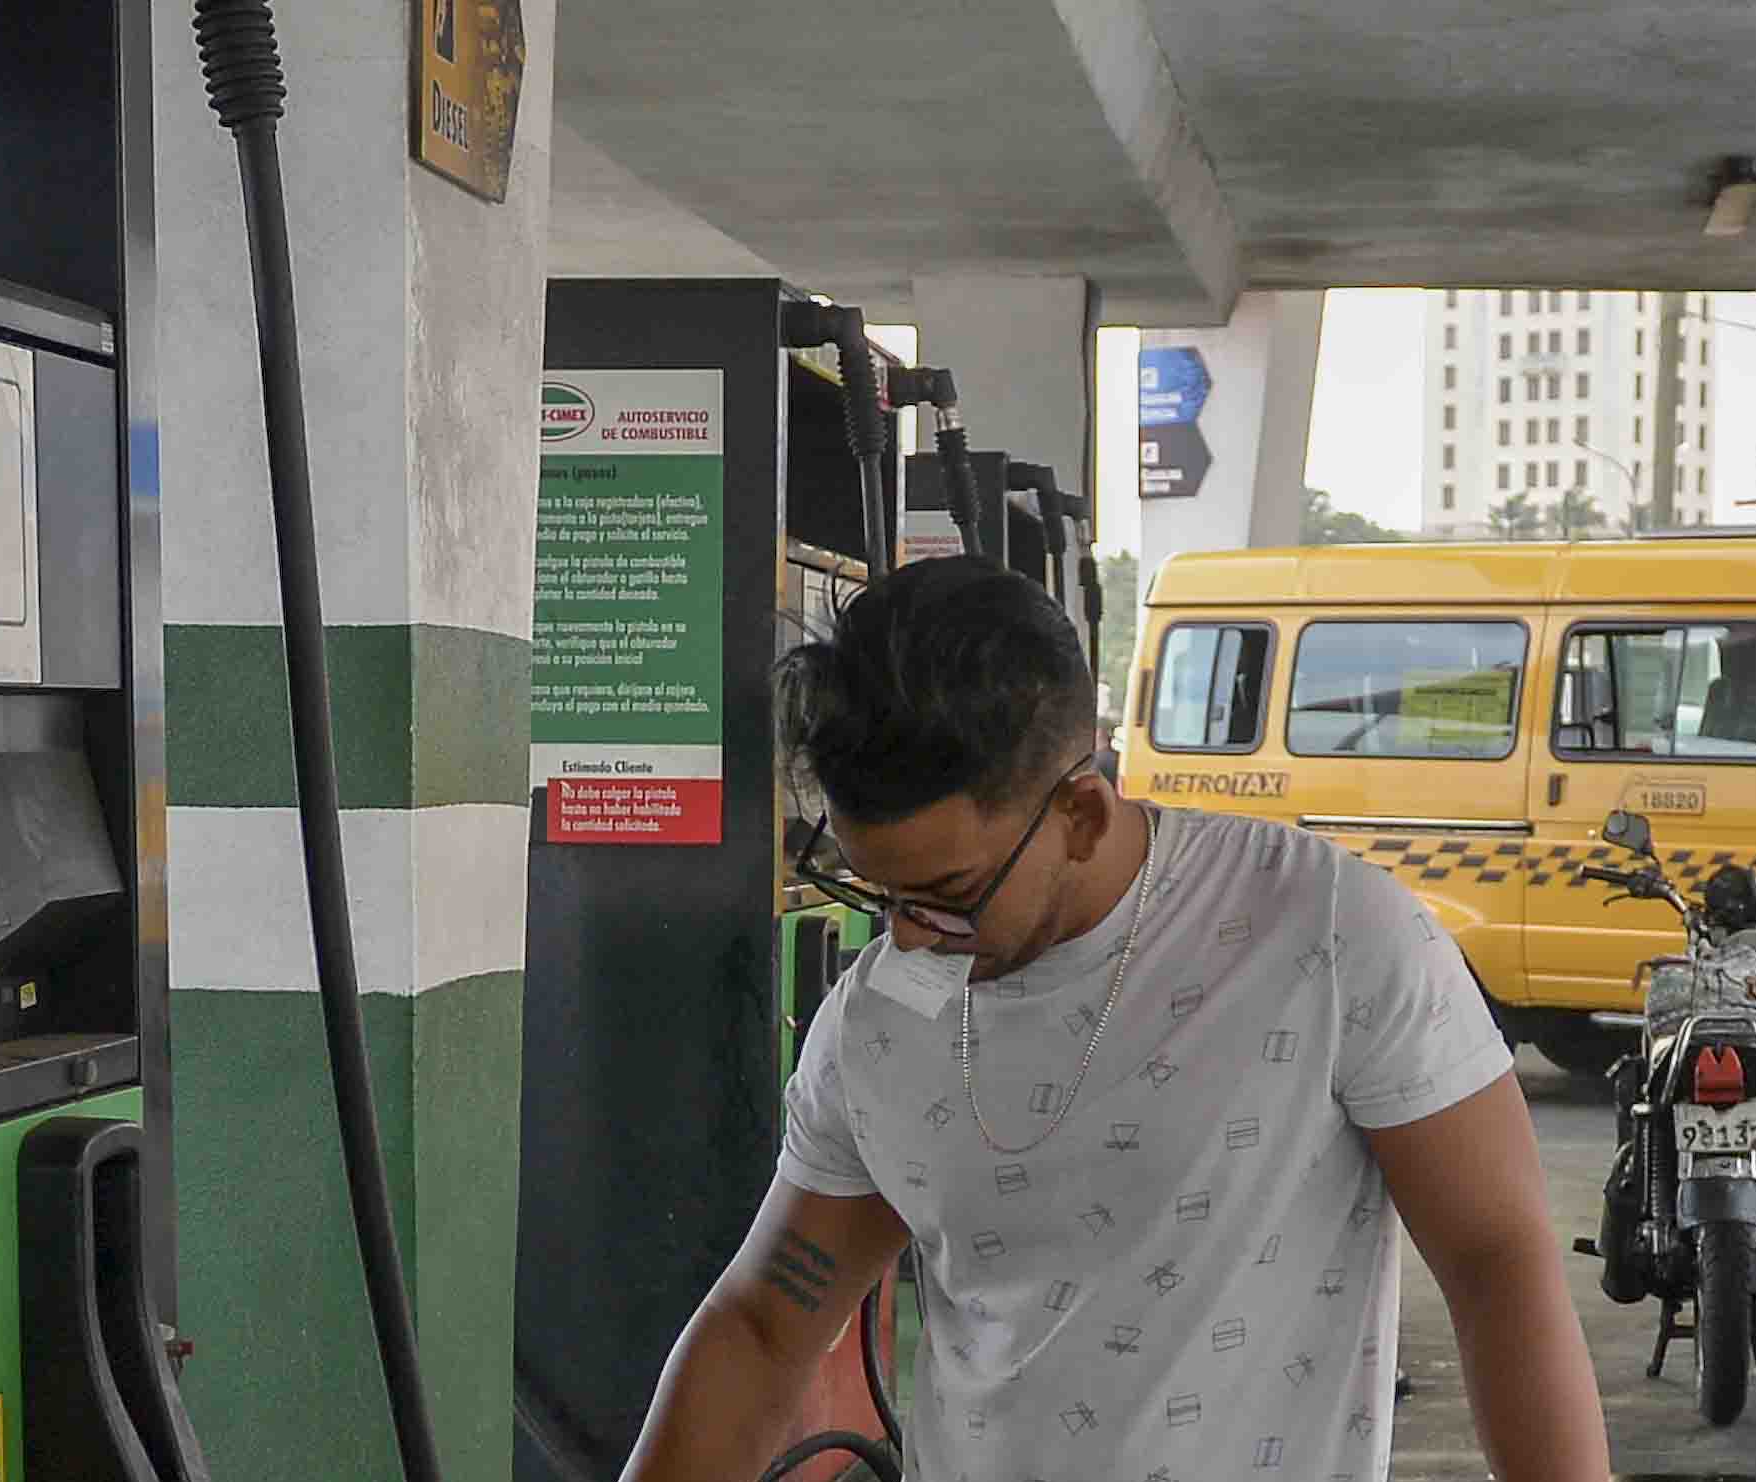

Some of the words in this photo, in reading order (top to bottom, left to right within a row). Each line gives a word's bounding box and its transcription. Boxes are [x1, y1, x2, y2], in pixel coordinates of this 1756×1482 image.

[433, 80, 467, 151] DIESEL
[541, 409, 587, 421] -CIMEX
[617, 411, 709, 424] AUTOSERVICIO
[602, 427, 618, 440] DE
[621, 427, 708, 440] COMBUSTIBLE
[563, 760, 612, 773] Estimado
[615, 760, 653, 773] Cliente
